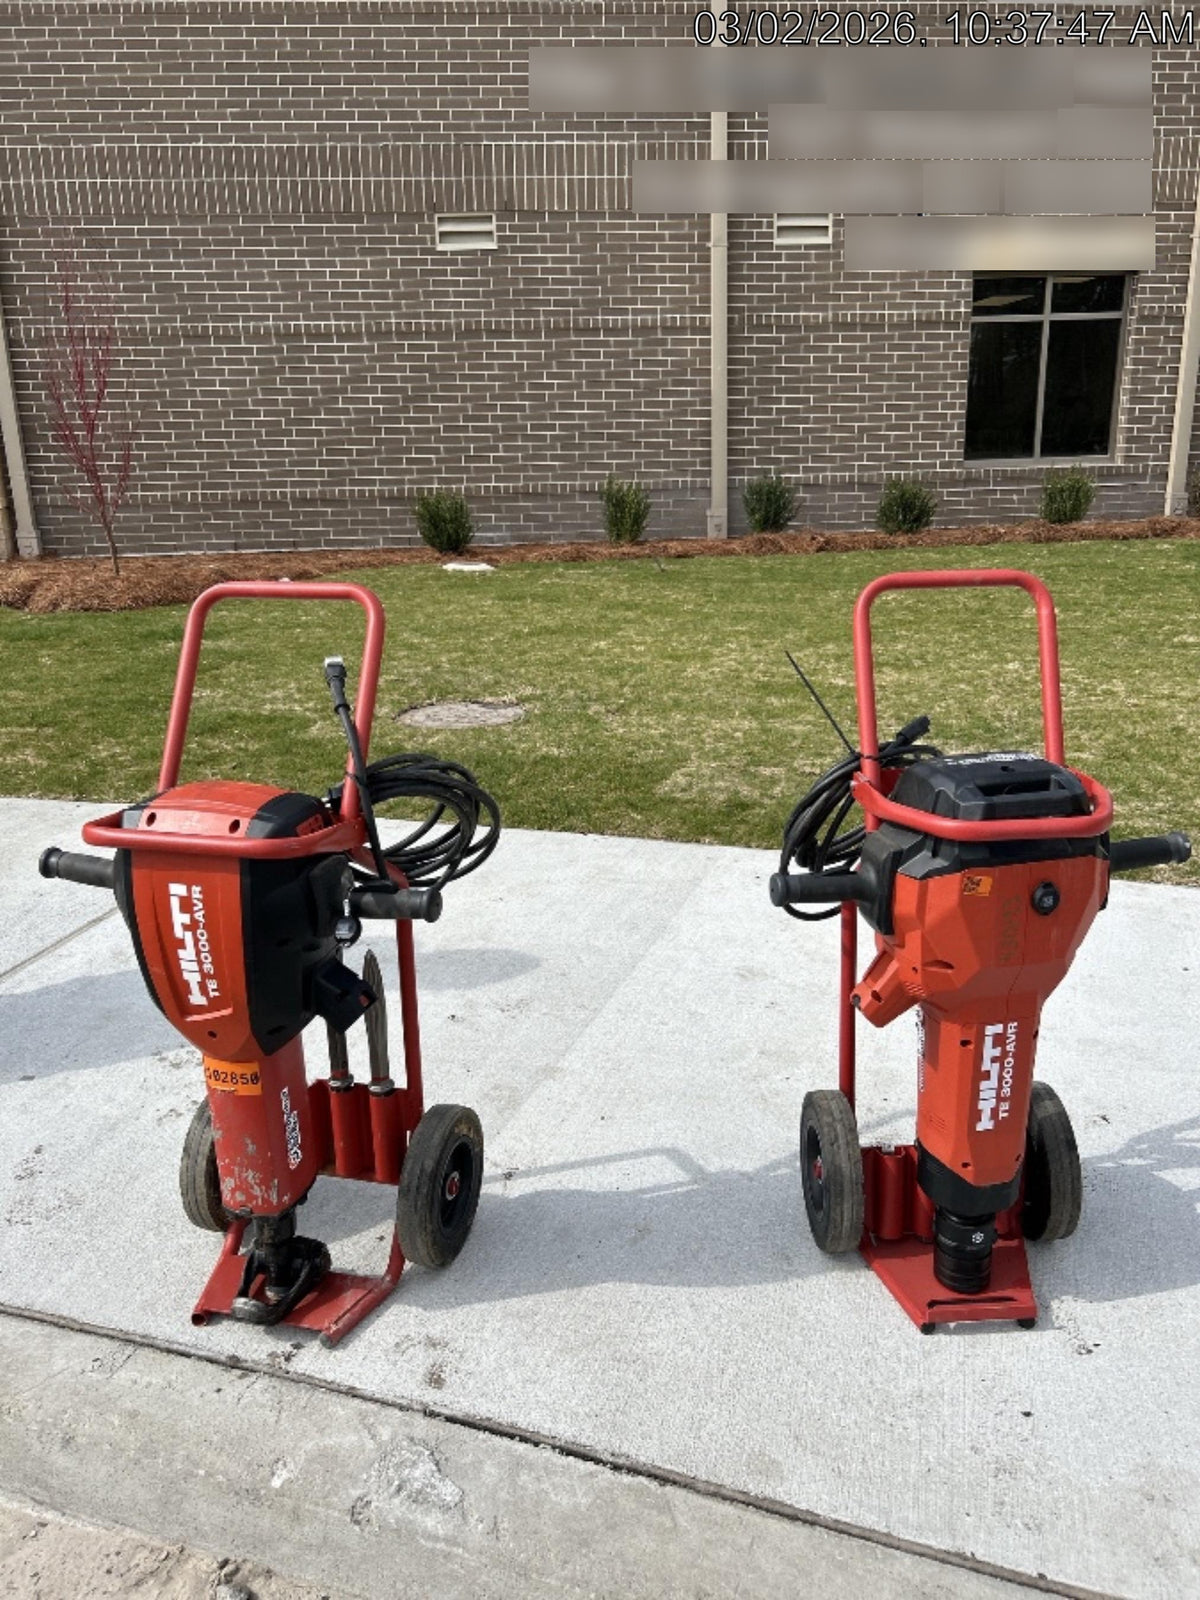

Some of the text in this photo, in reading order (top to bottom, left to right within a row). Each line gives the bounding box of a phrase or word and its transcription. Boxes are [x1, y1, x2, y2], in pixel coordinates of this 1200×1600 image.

[168, 883, 208, 1006] HILTI
[191, 885, 220, 998] TE 3000-AVR
[976, 1023, 1004, 1132] HILTI
[999, 1021, 1018, 1121] TE 3000-AVR
